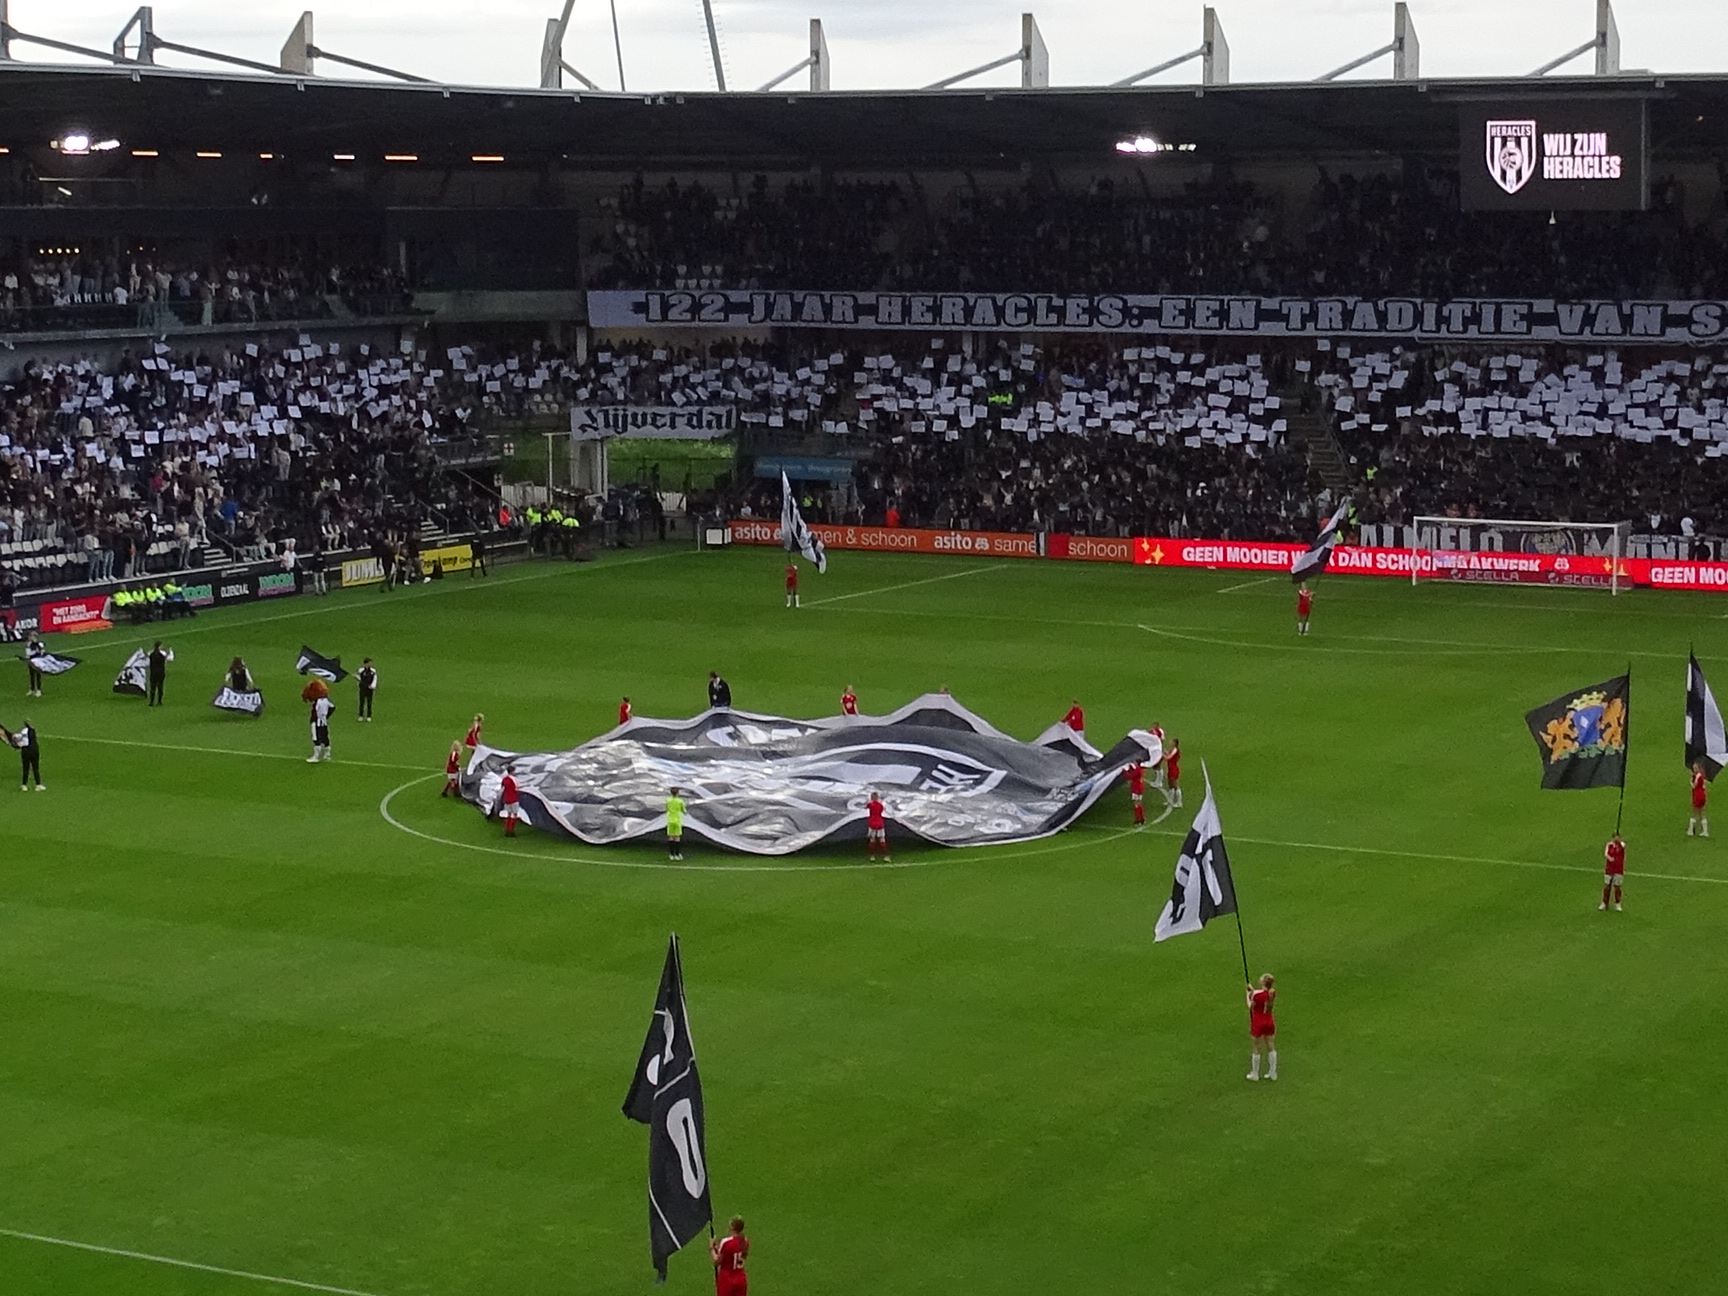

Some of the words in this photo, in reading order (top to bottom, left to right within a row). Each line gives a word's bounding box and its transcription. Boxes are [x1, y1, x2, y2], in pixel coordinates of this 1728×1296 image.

[1491, 125, 1531, 137] HERACLES
[1574, 133, 1607, 156] ZIJN
[1543, 156, 1621, 179] HERACLES
[646, 292, 729, 322] 122
[748, 292, 859, 324] JAAR
[876, 294, 1141, 328] HERACLES:
[1160, 297, 1261, 331] EEN
[1280, 299, 1532, 334] TRADITIE
[1556, 302, 1667, 337] VAN
[735, 523, 771, 541] asito
[845, 529, 857, 543] &
[861, 530, 917, 547] schoon
[934, 531, 971, 550] asito
[995, 537, 1036, 553] same
[1068, 540, 1127, 557] schoon
[1182, 546, 1224, 562] GEEN
[1227, 547, 1288, 565] MOOIER
[1338, 551, 1373, 567] DAN
[1651, 566, 1696, 584] GEEN
